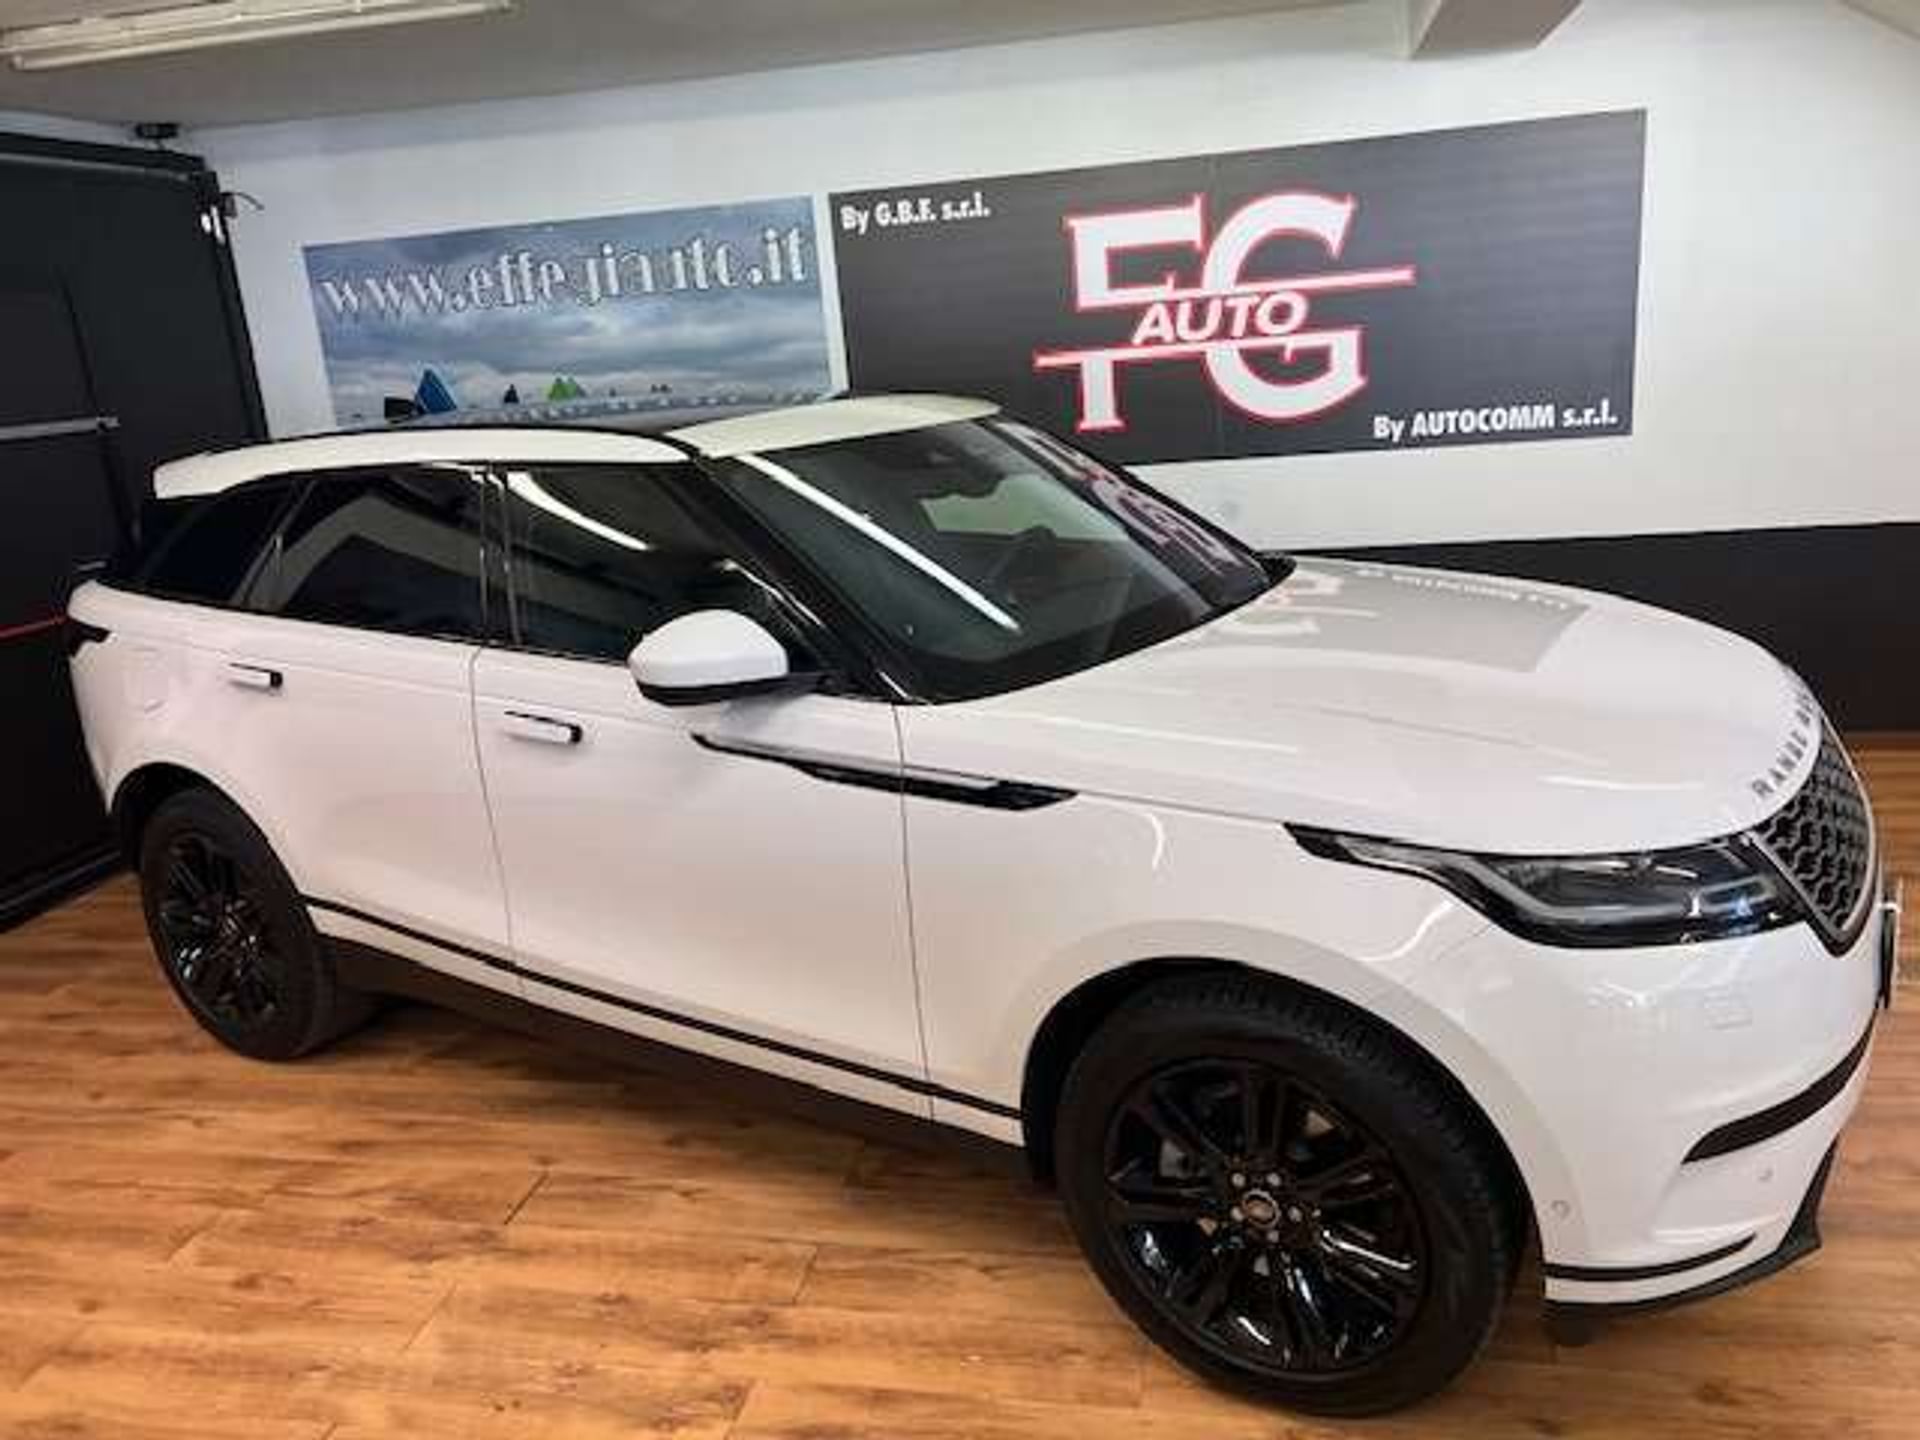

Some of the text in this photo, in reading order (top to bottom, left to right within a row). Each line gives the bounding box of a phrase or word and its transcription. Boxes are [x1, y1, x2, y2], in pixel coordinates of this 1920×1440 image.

[840, 191, 991, 235] By G.B.F. s.r.l.
[1131, 290, 1309, 346] AUTO
[1373, 398, 1618, 442] By AUTOCOMM s.r.l.
